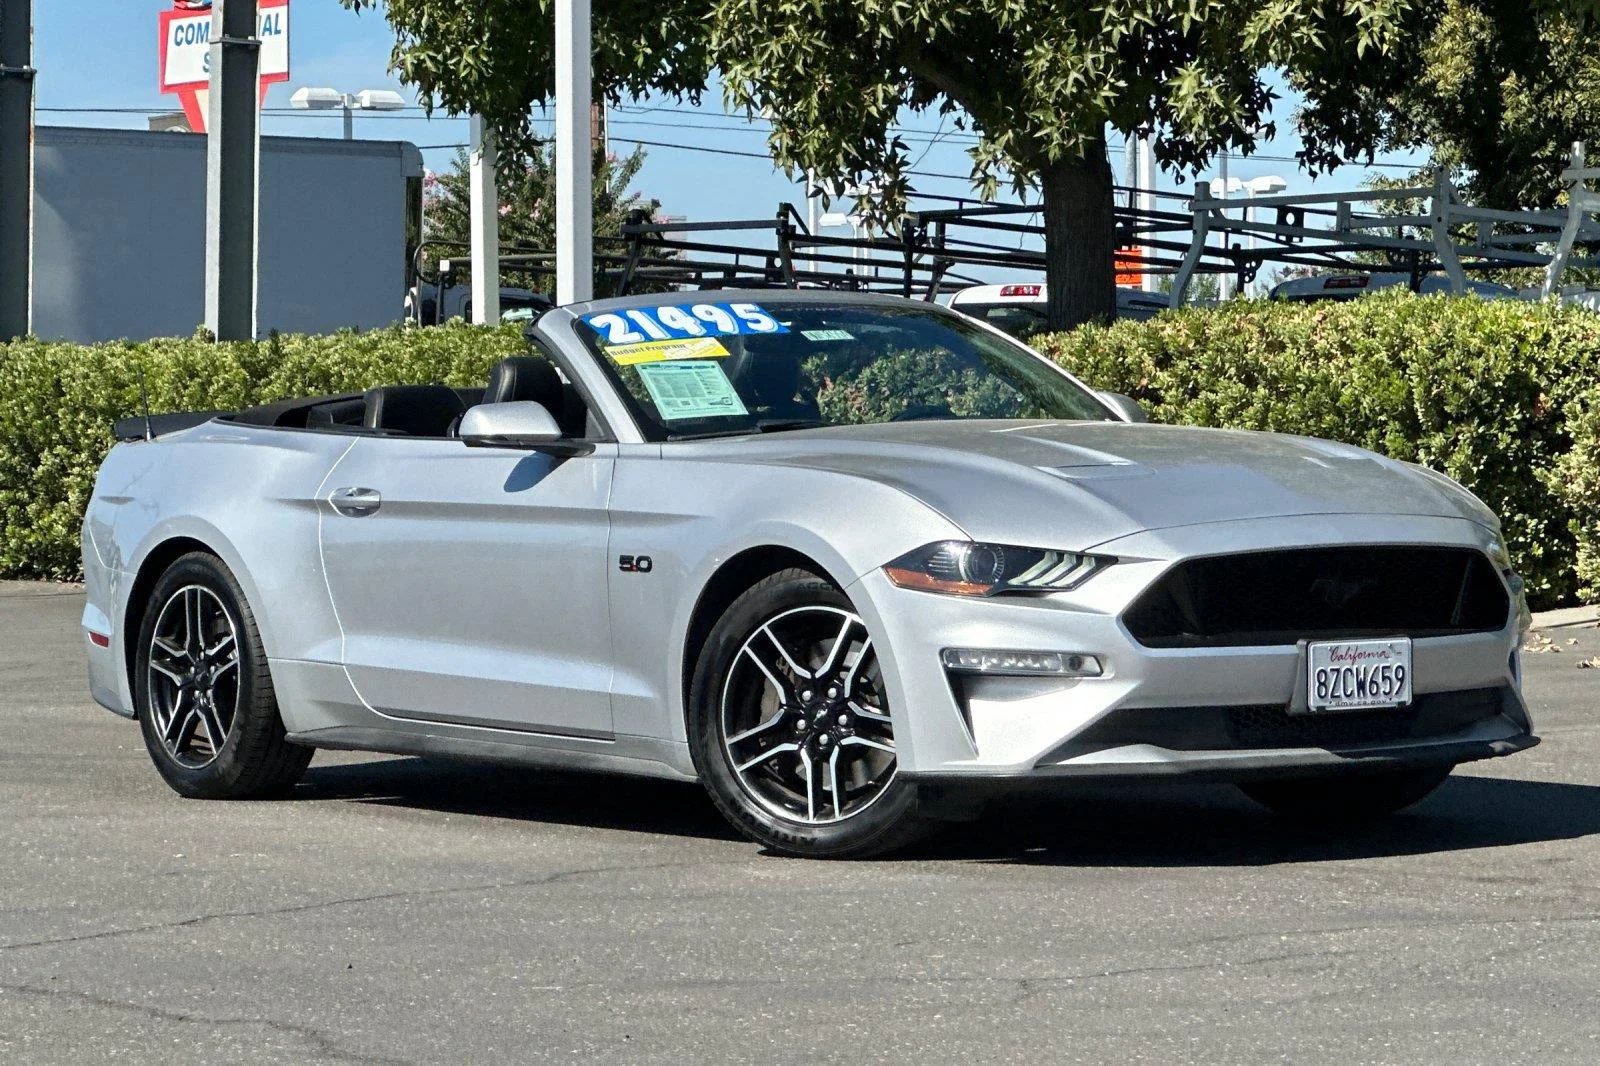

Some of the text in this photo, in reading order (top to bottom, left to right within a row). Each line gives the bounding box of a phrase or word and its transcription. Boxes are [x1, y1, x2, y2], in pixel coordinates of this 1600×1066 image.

[174, 13, 282, 46] COMAL
[589, 303, 779, 344] 21495
[610, 343, 687, 357] Budget Program
[619, 555, 653, 573] 5.0
[1330, 646, 1391, 665] California
[1316, 663, 1405, 699] 8ZCW659
